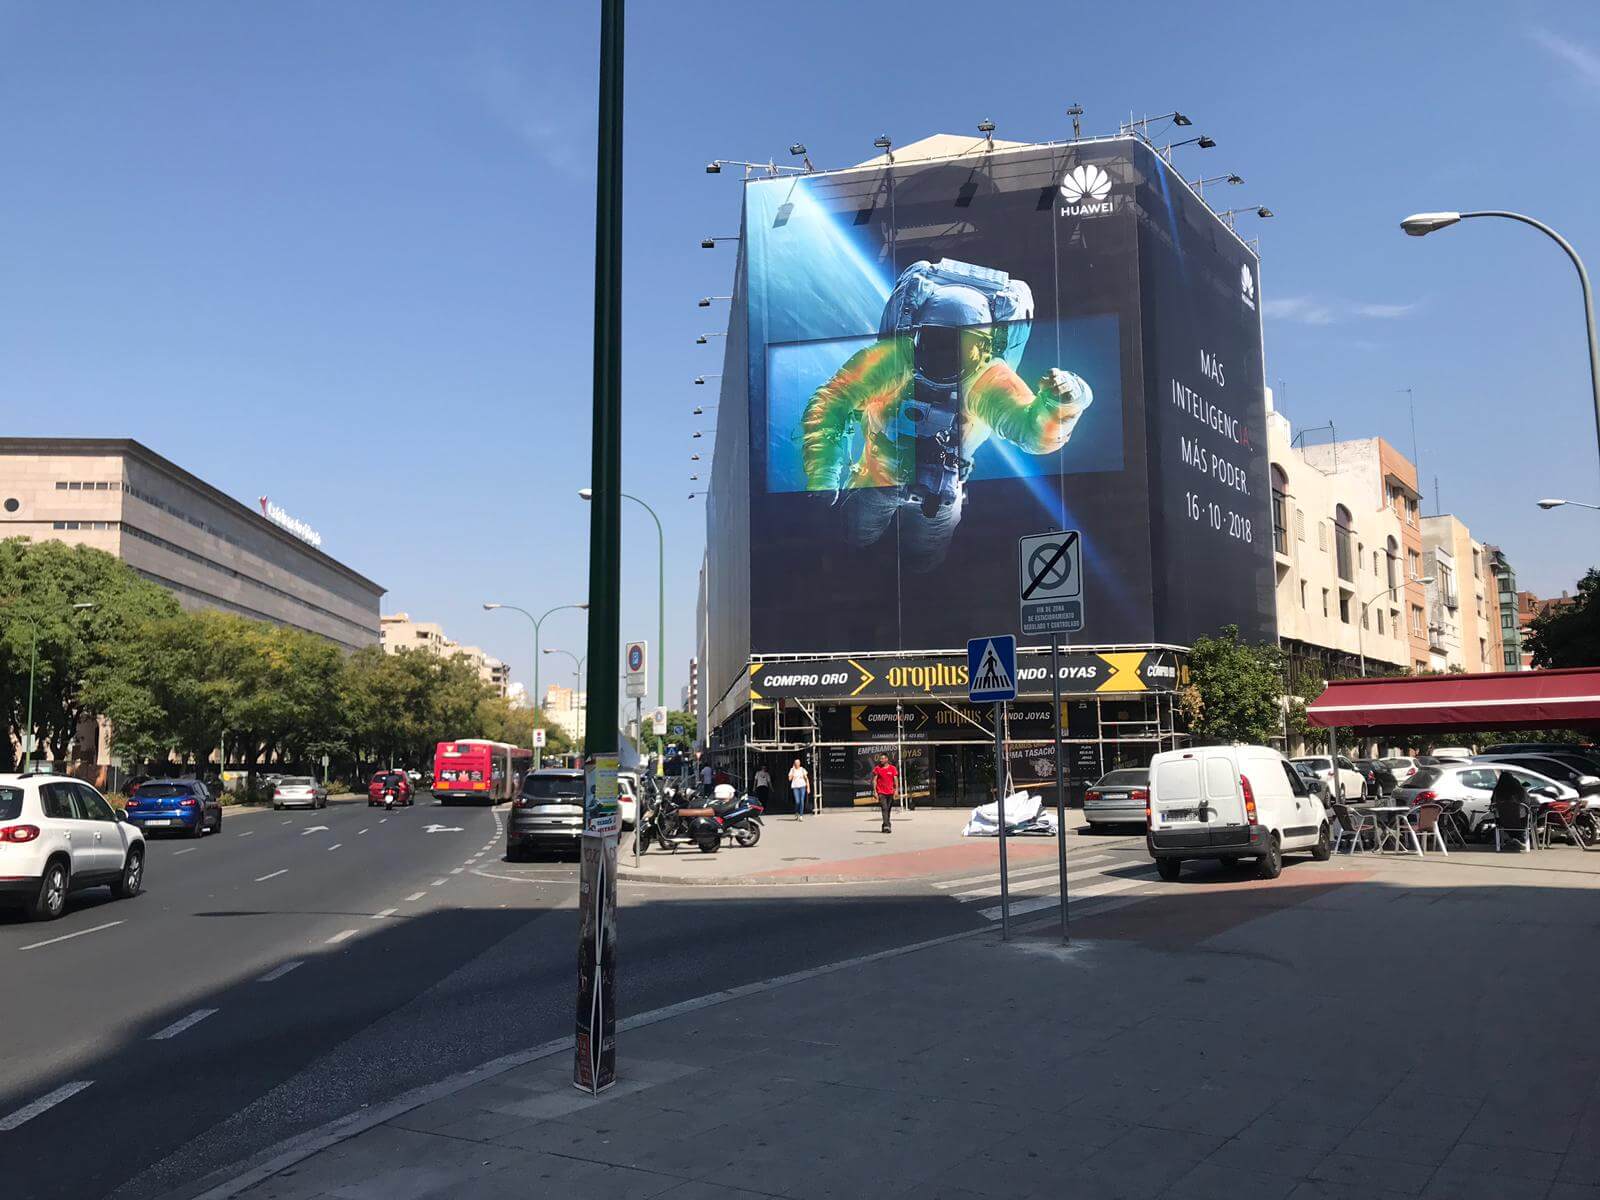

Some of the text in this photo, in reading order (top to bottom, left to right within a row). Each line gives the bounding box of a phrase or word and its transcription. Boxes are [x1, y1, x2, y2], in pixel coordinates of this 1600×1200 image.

[1061, 202, 1114, 217] HUAWEI
[1201, 349, 1225, 387] MÁS
[1181, 436, 1251, 496] MÁS PODER.
[763, 672, 849, 687] COMPRO ORO
[889, 663, 969, 691] oroplus
[1016, 666, 1097, 680] NDO OYAS
[1025, 711, 1051, 720] JOYAS
